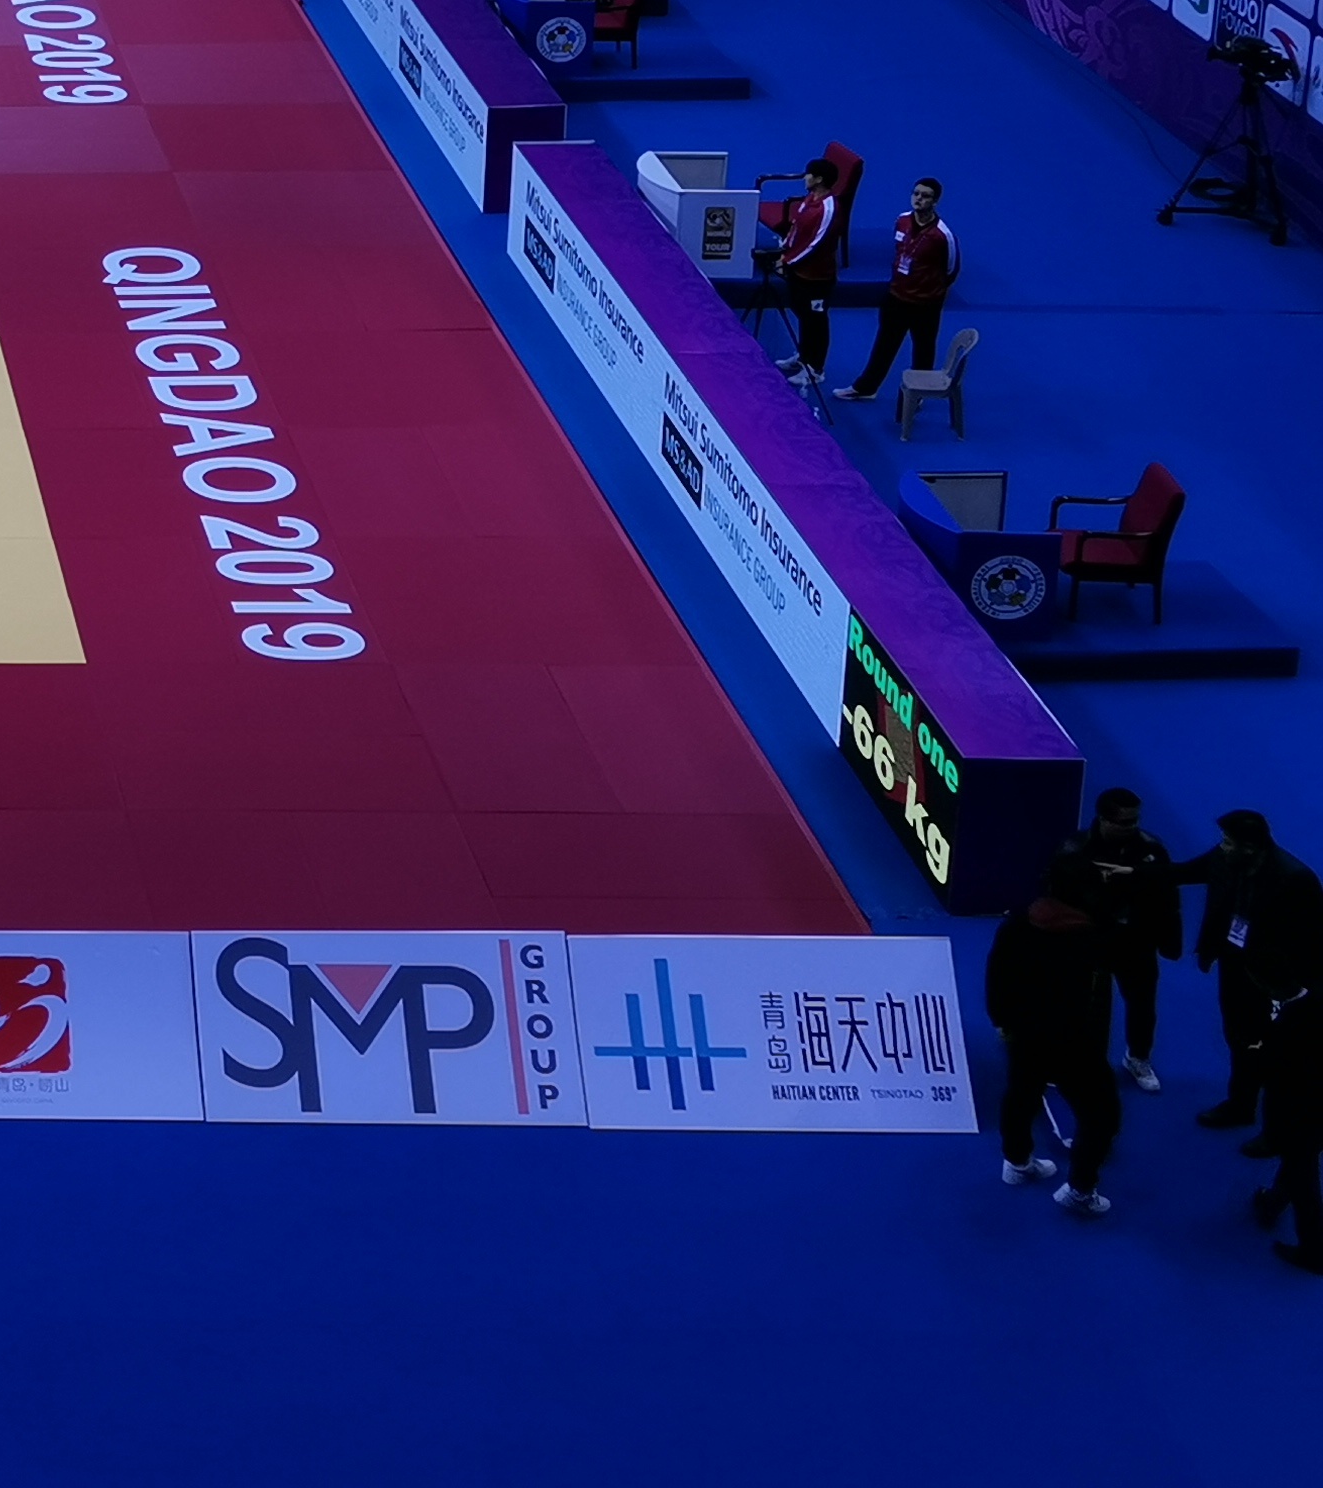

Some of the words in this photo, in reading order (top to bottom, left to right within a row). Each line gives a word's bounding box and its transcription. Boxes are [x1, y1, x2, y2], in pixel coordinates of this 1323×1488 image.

[24, 33, 128, 105] 2019
[526, 227, 554, 283] MS&AD
[526, 180, 553, 227] Mitsui
[552, 216, 598, 289] Sumitomo
[598, 279, 645, 364] Insurance
[101, 246, 297, 504] QINGDAO
[199, 515, 367, 661] 2019
[664, 372, 699, 439] Mitsui
[700, 425, 759, 525] Sumitomo
[760, 506, 822, 617] Insurance
[665, 430, 700, 497] MS&AD
[704, 485, 753, 575] INSURANCE
[754, 566, 786, 616] GROUP
[849, 613, 915, 728] Round
[917, 717, 959, 795] one
[842, 704, 897, 790] -66
[904, 777, 952, 885] kg
[215, 937, 496, 1115] SMP
[519, 943, 561, 1110] GROUP
[760, 991, 791, 1073] 青岛
[772, 1085, 817, 1101] HAITIAN
[819, 1086, 860, 1101] CENTER
[794, 991, 955, 1074] 海天中心
